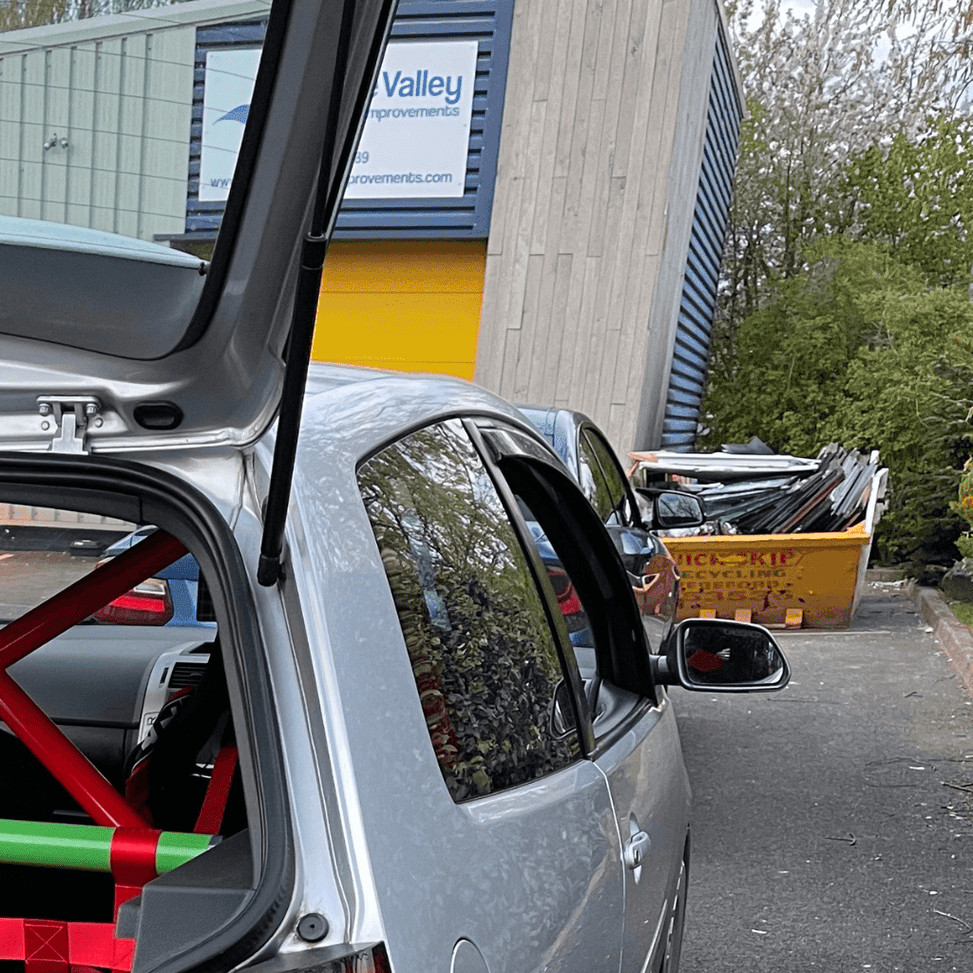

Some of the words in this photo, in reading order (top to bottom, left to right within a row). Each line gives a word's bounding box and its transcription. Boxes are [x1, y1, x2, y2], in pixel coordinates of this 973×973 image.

[382, 69, 463, 104] Valley
[370, 105, 460, 122] mprovements
[680, 569, 787, 579] ECYCLING
